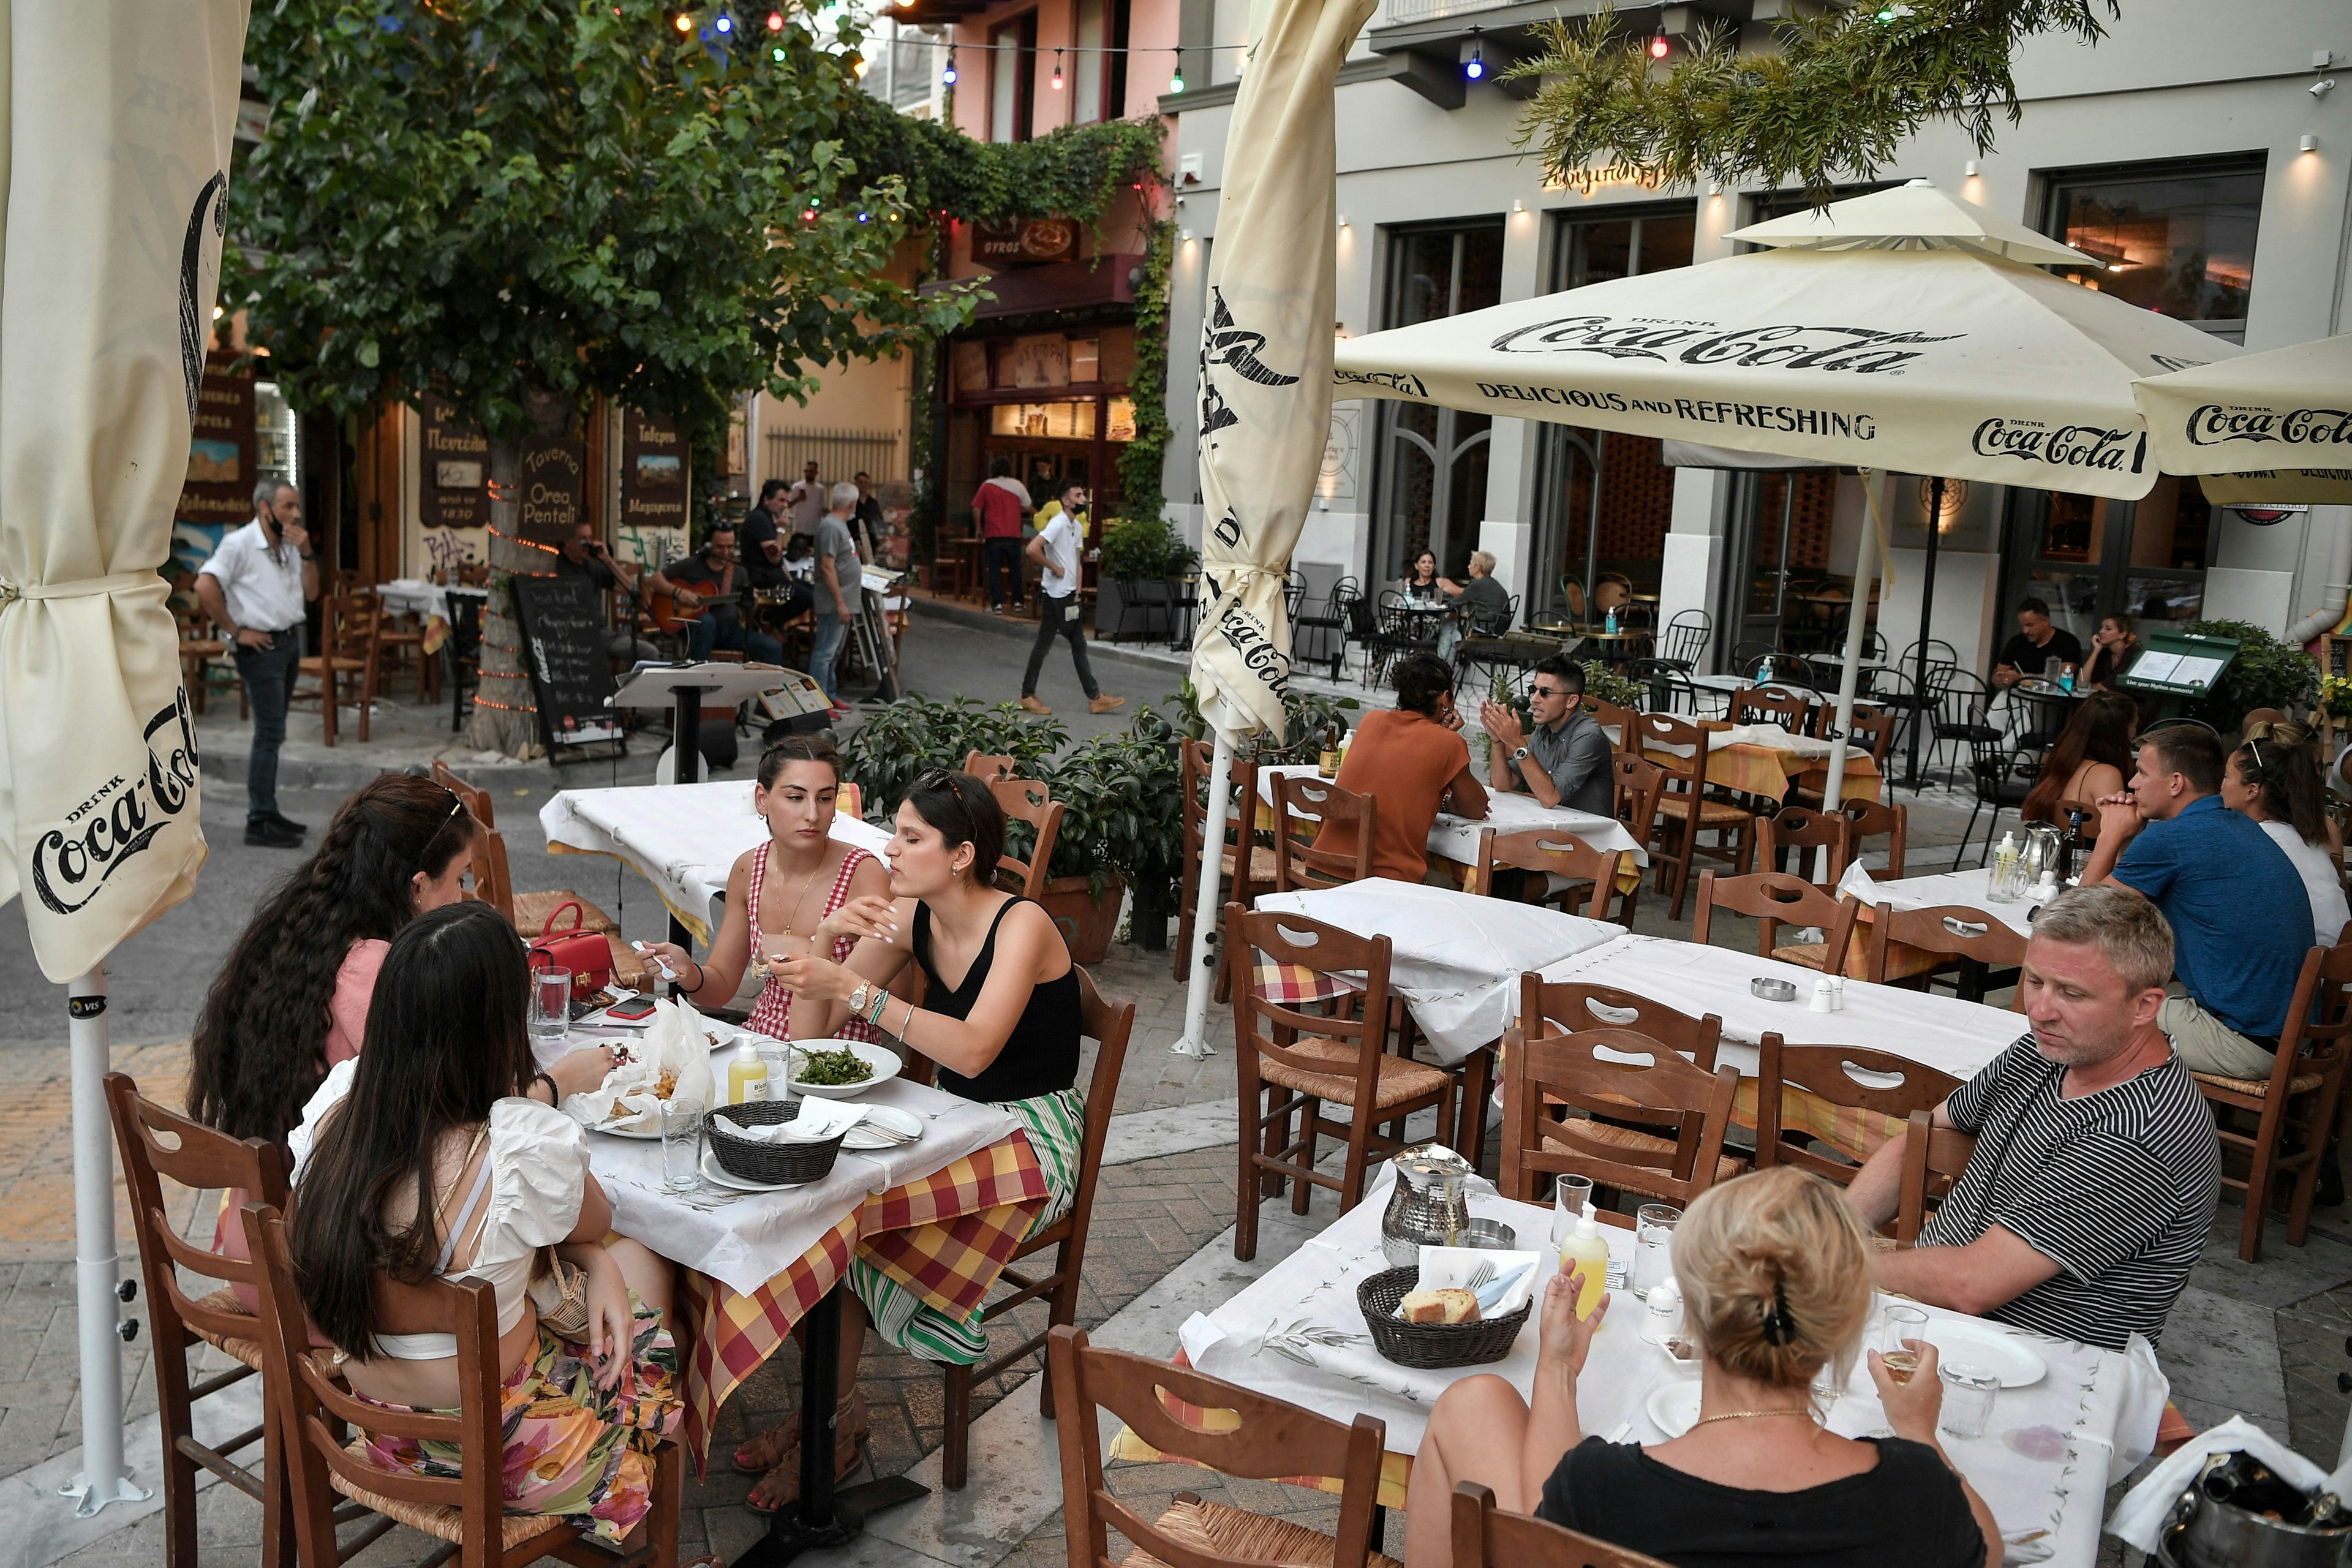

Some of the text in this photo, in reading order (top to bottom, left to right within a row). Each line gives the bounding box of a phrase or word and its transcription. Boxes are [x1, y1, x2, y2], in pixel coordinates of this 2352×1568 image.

[984, 242, 1020, 253] GYROS
[1629, 317, 1720, 327] DRINK
[1490, 316, 1969, 374] Coca-Cola
[1476, 382, 1876, 441] DELICIOUS AND REFRESHING
[2010, 419, 2046, 428] DRINK
[2185, 404, 2352, 446] Coca-Col
[1972, 418, 2133, 470] Coca-Cola
[526, 448, 579, 475] Taverna
[530, 483, 570, 505] Orea
[524, 502, 576, 524] Penteli
[1242, 610, 1267, 632] RINK
[2150, 682, 2169, 691] Mythos
[2169, 686, 2195, 695] moments!
[65, 774, 126, 824] DRINK
[85, 1001, 99, 1012] VIS
